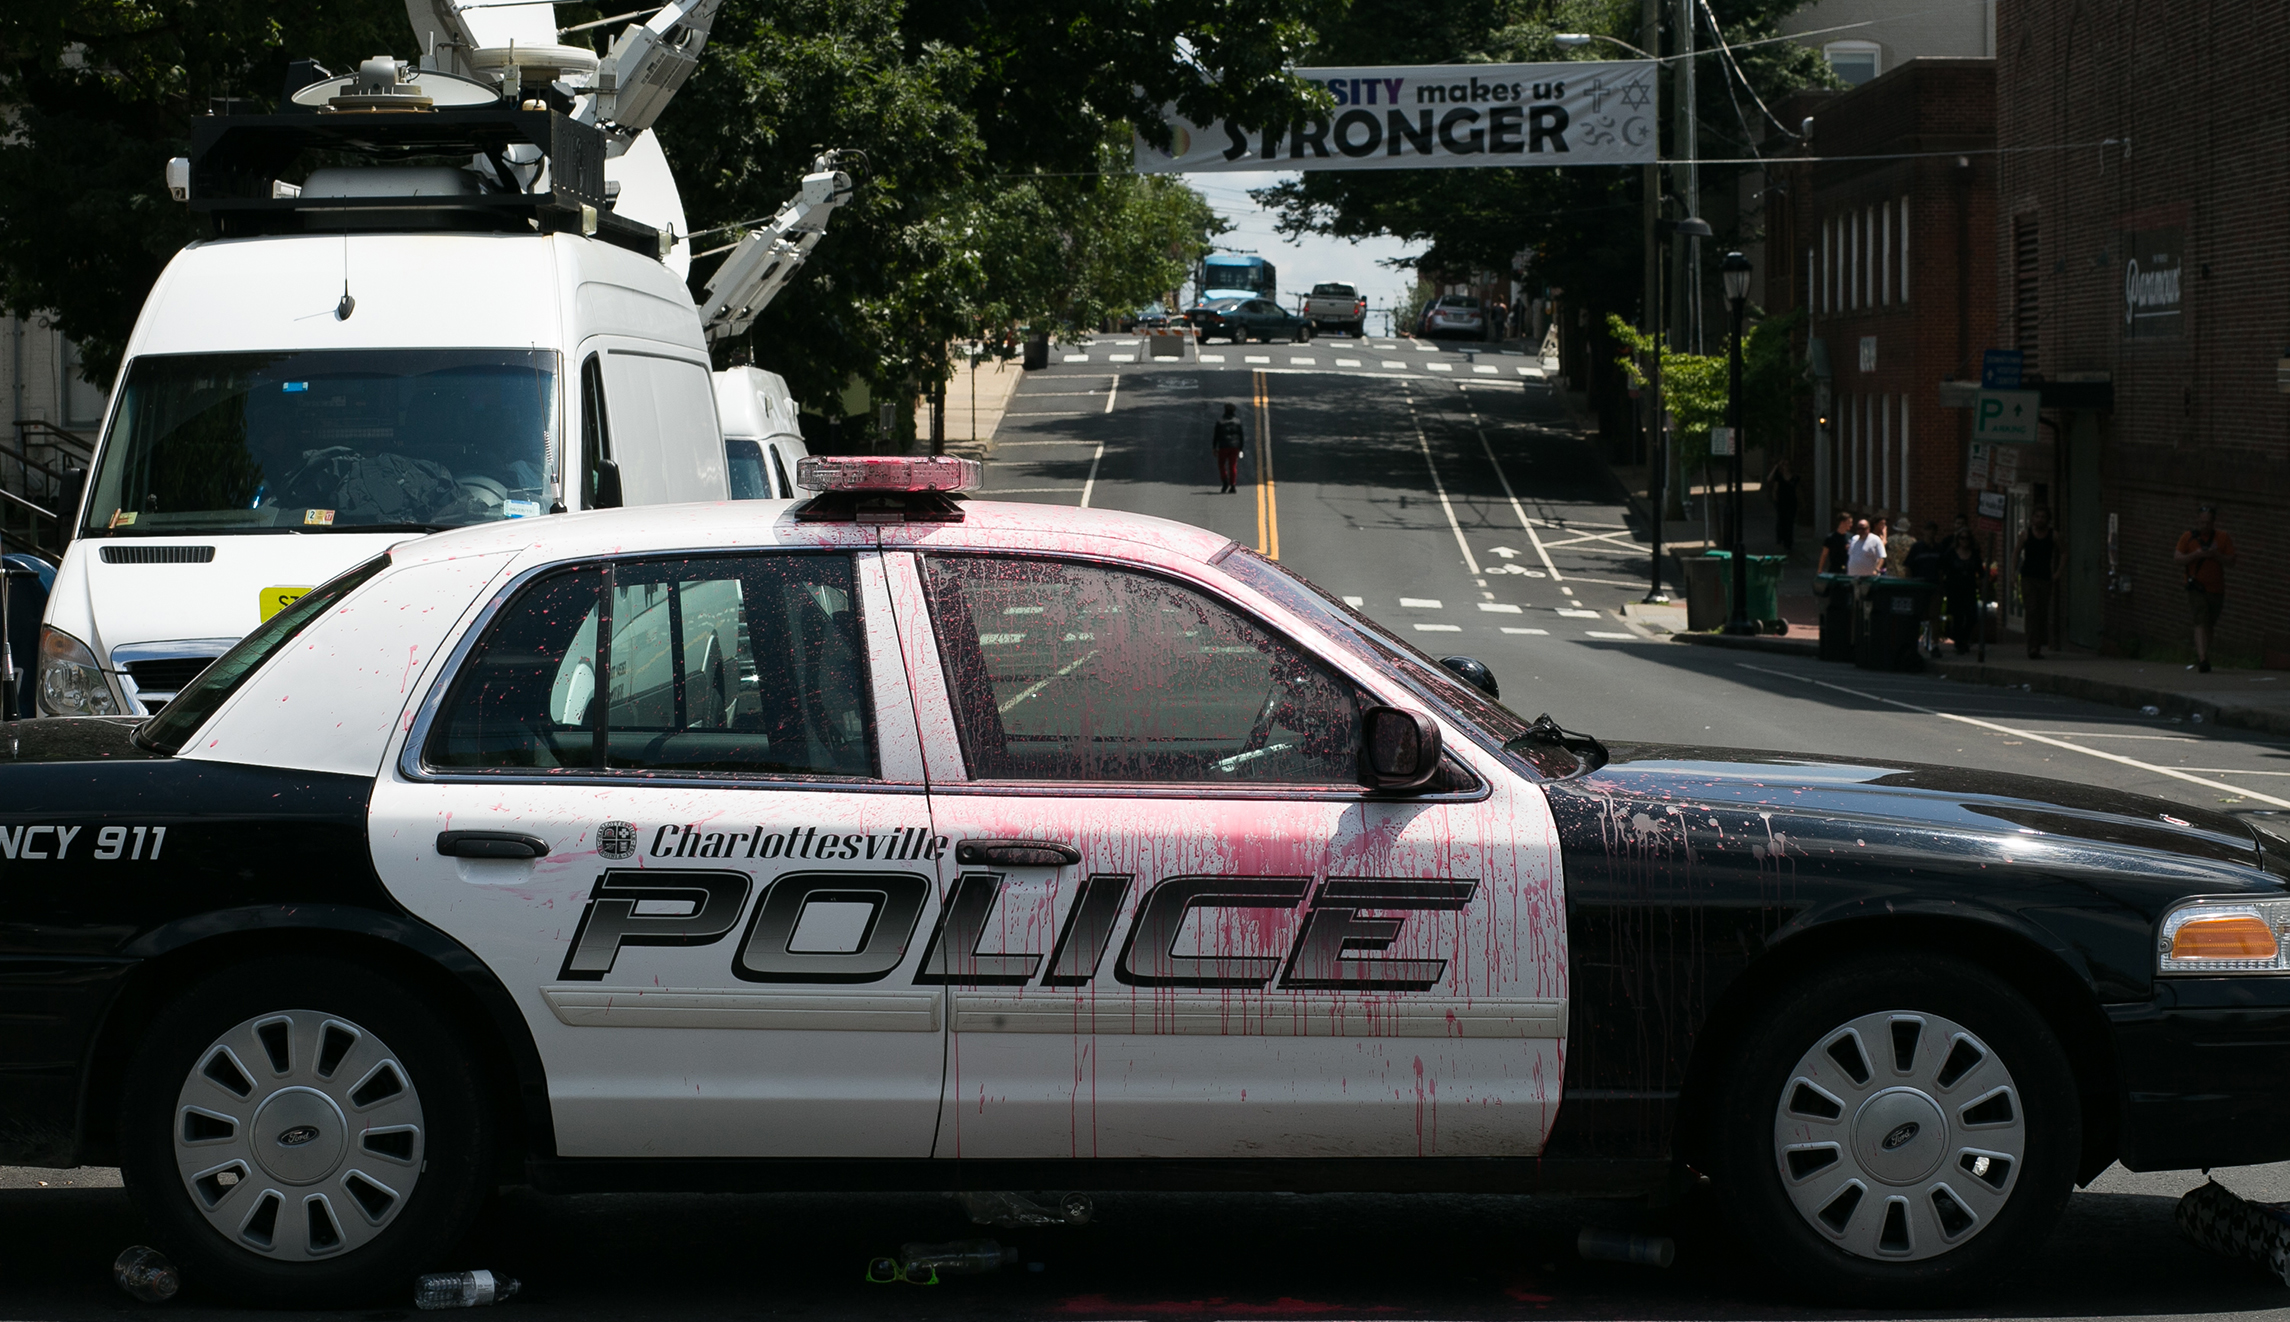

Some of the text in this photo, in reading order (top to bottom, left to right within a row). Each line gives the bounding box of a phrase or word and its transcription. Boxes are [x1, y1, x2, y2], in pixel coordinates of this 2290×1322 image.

[1417, 77, 1521, 104] makes
[1532, 81, 1566, 101] us
[309, 511, 316, 519] 2
[94, 826, 167, 860] 911
[650, 823, 949, 861] Charlottesville
[557, 867, 1480, 991] POLICE
[288, 1130, 309, 1143] Ford
[1891, 1129, 1911, 1146] Ford
